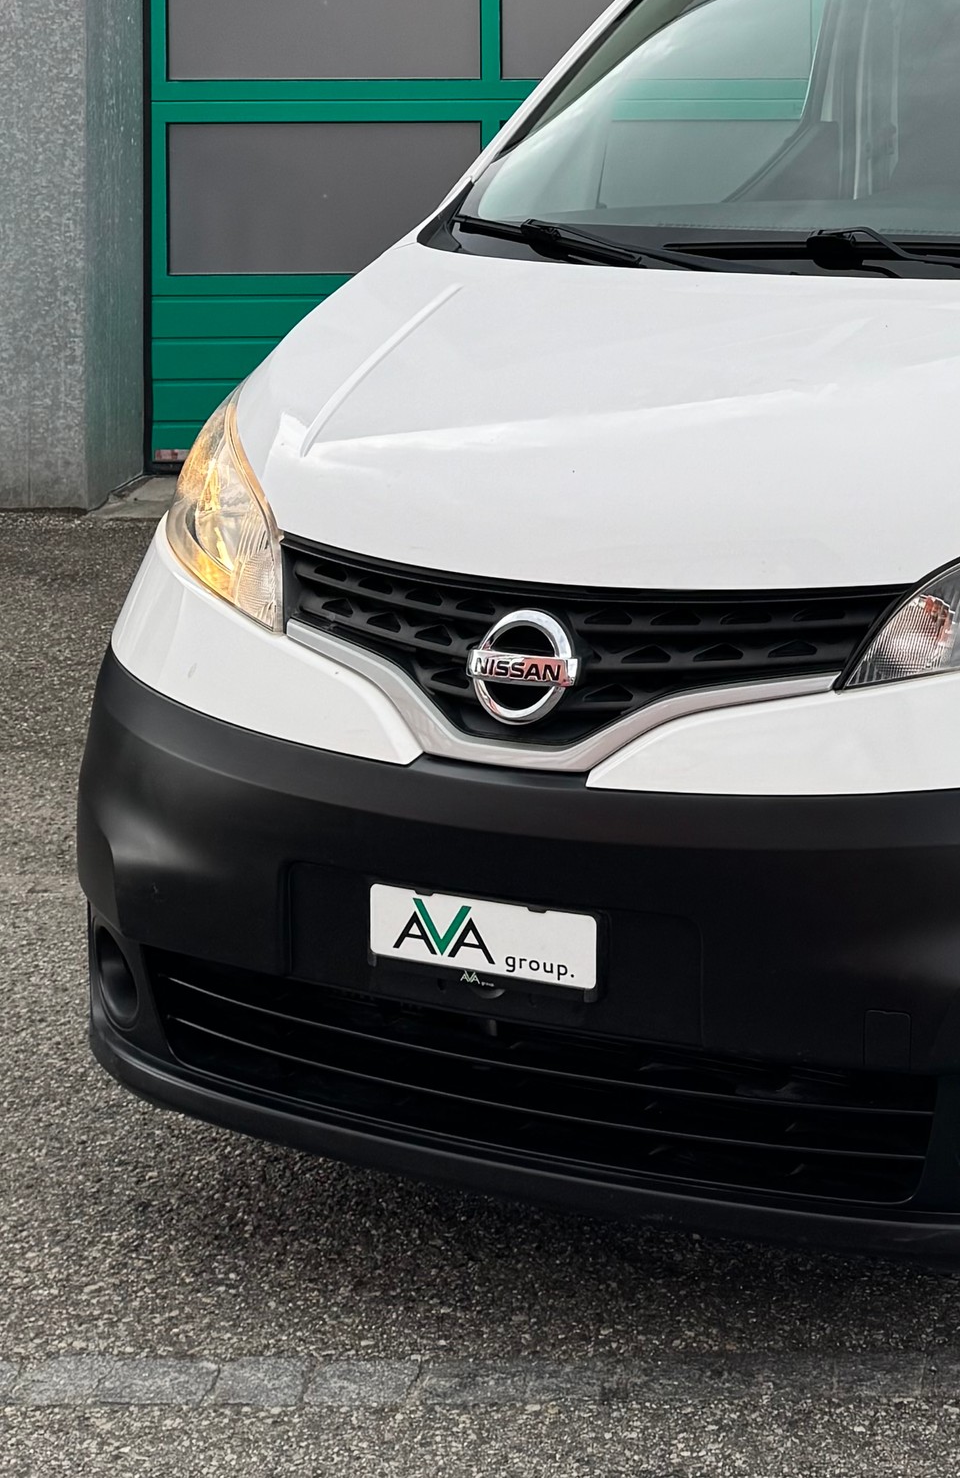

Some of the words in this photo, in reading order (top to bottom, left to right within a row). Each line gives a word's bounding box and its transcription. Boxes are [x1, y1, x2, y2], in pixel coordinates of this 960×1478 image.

[474, 657, 561, 682] NISSAN
[393, 897, 496, 965] AVA
[505, 955, 575, 981] group.
[460, 969, 481, 985] AVA
